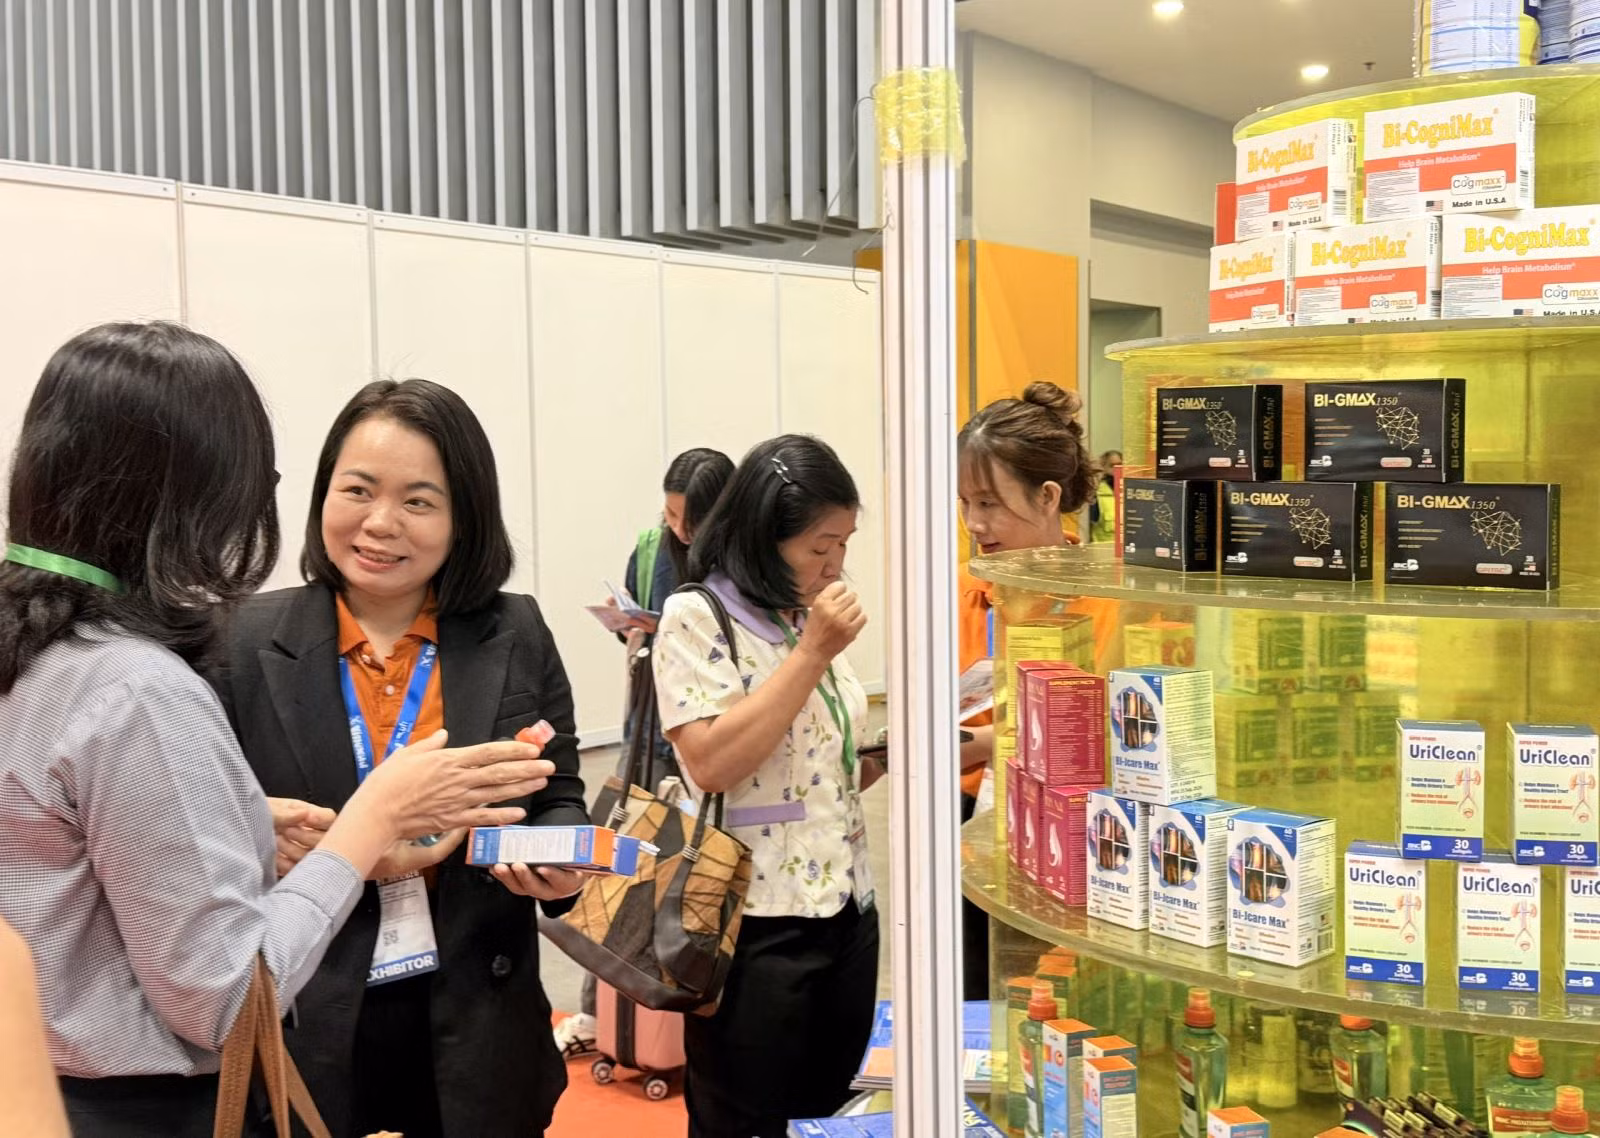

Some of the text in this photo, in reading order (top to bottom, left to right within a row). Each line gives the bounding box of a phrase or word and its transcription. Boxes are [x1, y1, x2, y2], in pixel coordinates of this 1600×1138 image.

[1382, 113, 1493, 149] Bi-CogniMax
[1247, 139, 1315, 173] Bi-CogniMax
[1452, 196, 1507, 208] Made in U.S.A
[1464, 222, 1590, 256] Bi-CogniMax
[1311, 235, 1407, 268] Bi-CogniMax
[1219, 252, 1273, 281] Bi-CogniMax
[1482, 266, 1501, 275] Help
[1502, 265, 1523, 274] Brain
[1162, 397, 1207, 410] BI-GMAX
[1314, 393, 1376, 407] BI-GMAX
[1230, 492, 1290, 506] BI-GMAX
[1397, 495, 1471, 509] BI-GMAX
[1409, 744, 1476, 761] UriClean
[1520, 749, 1590, 766] UriClean
[1143, 759, 1158, 770] Max
[1454, 839, 1469, 849] 30
[1569, 844, 1585, 854] 30
[1349, 867, 1416, 887] UriClean
[1116, 882, 1129, 894] Max
[1463, 876, 1532, 894] UriClean
[1183, 898, 1198, 910] Max
[1268, 915, 1287, 929] Max
[366, 955, 435, 982] XHIBITOR
[1396, 964, 1412, 974] 30
[1511, 972, 1526, 982] 30
